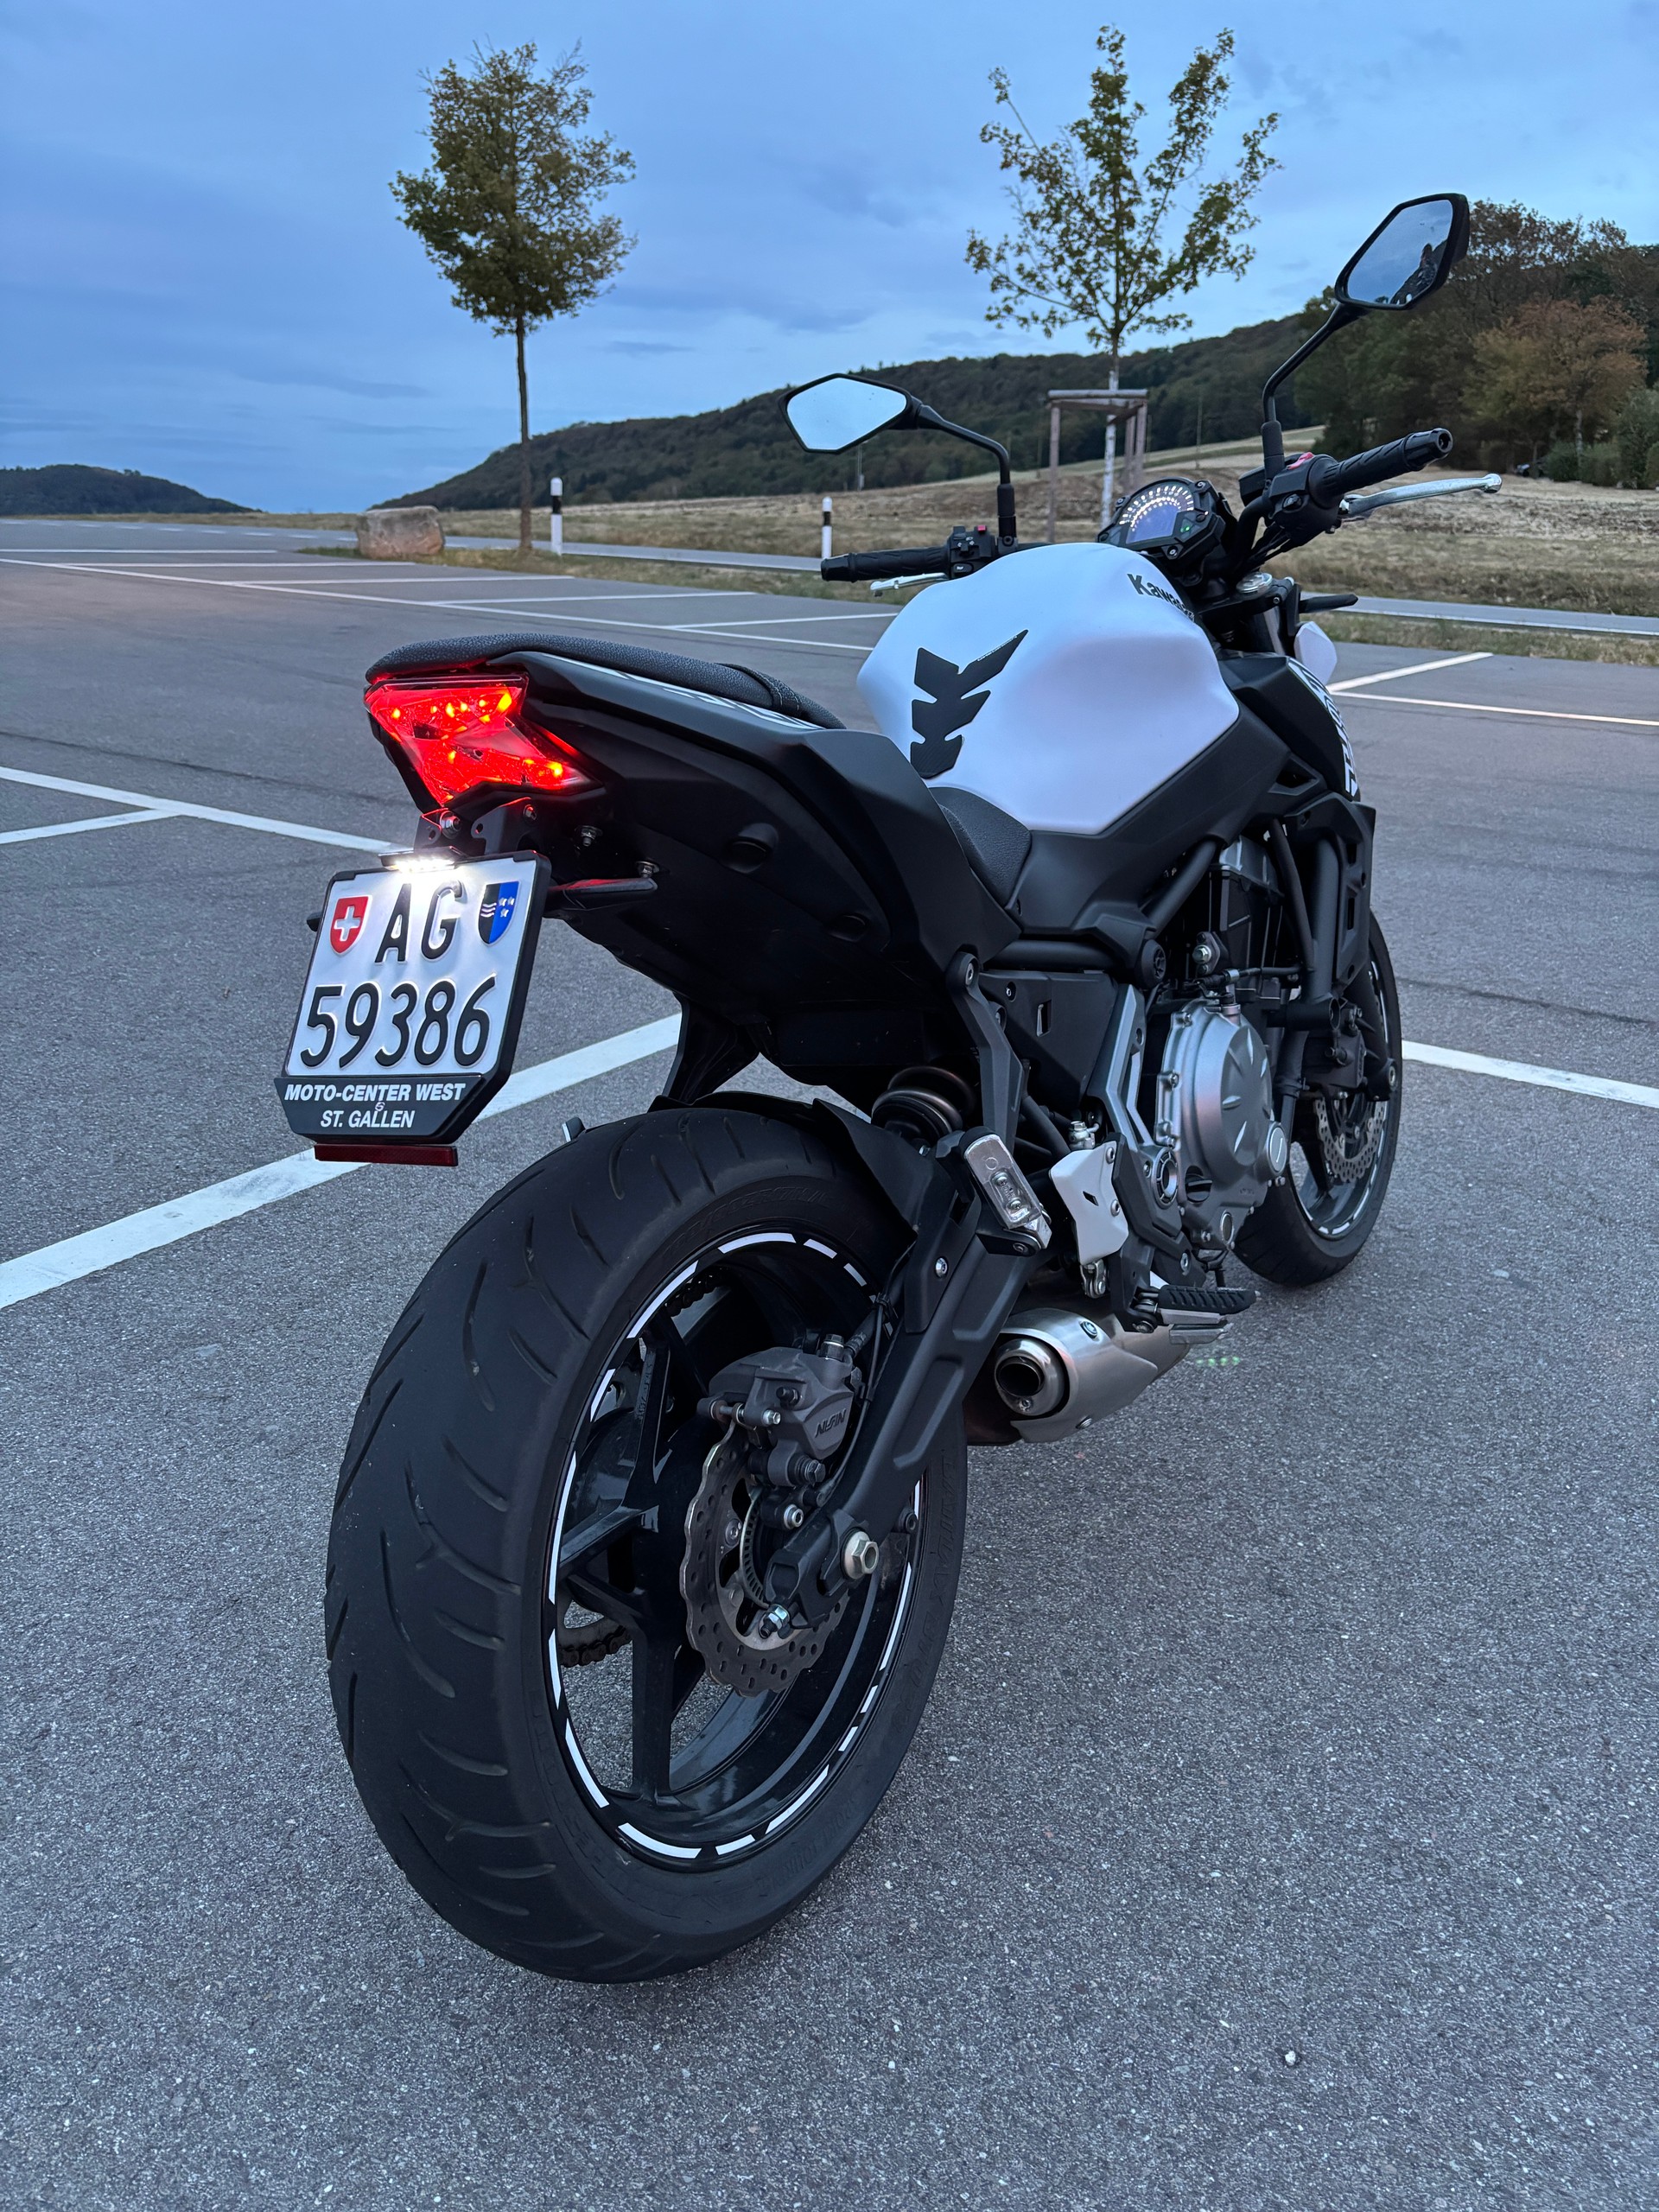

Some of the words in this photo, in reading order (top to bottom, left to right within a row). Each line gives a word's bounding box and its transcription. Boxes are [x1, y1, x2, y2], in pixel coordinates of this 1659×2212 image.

[375, 880, 463, 963] AG
[301, 976, 496, 1068] 59386
[284, 1084, 411, 1101] MOTO-CENTER
[416, 1084, 466, 1101] WEST
[321, 1110, 344, 1128] ST.
[348, 1110, 415, 1128] GALLEN
